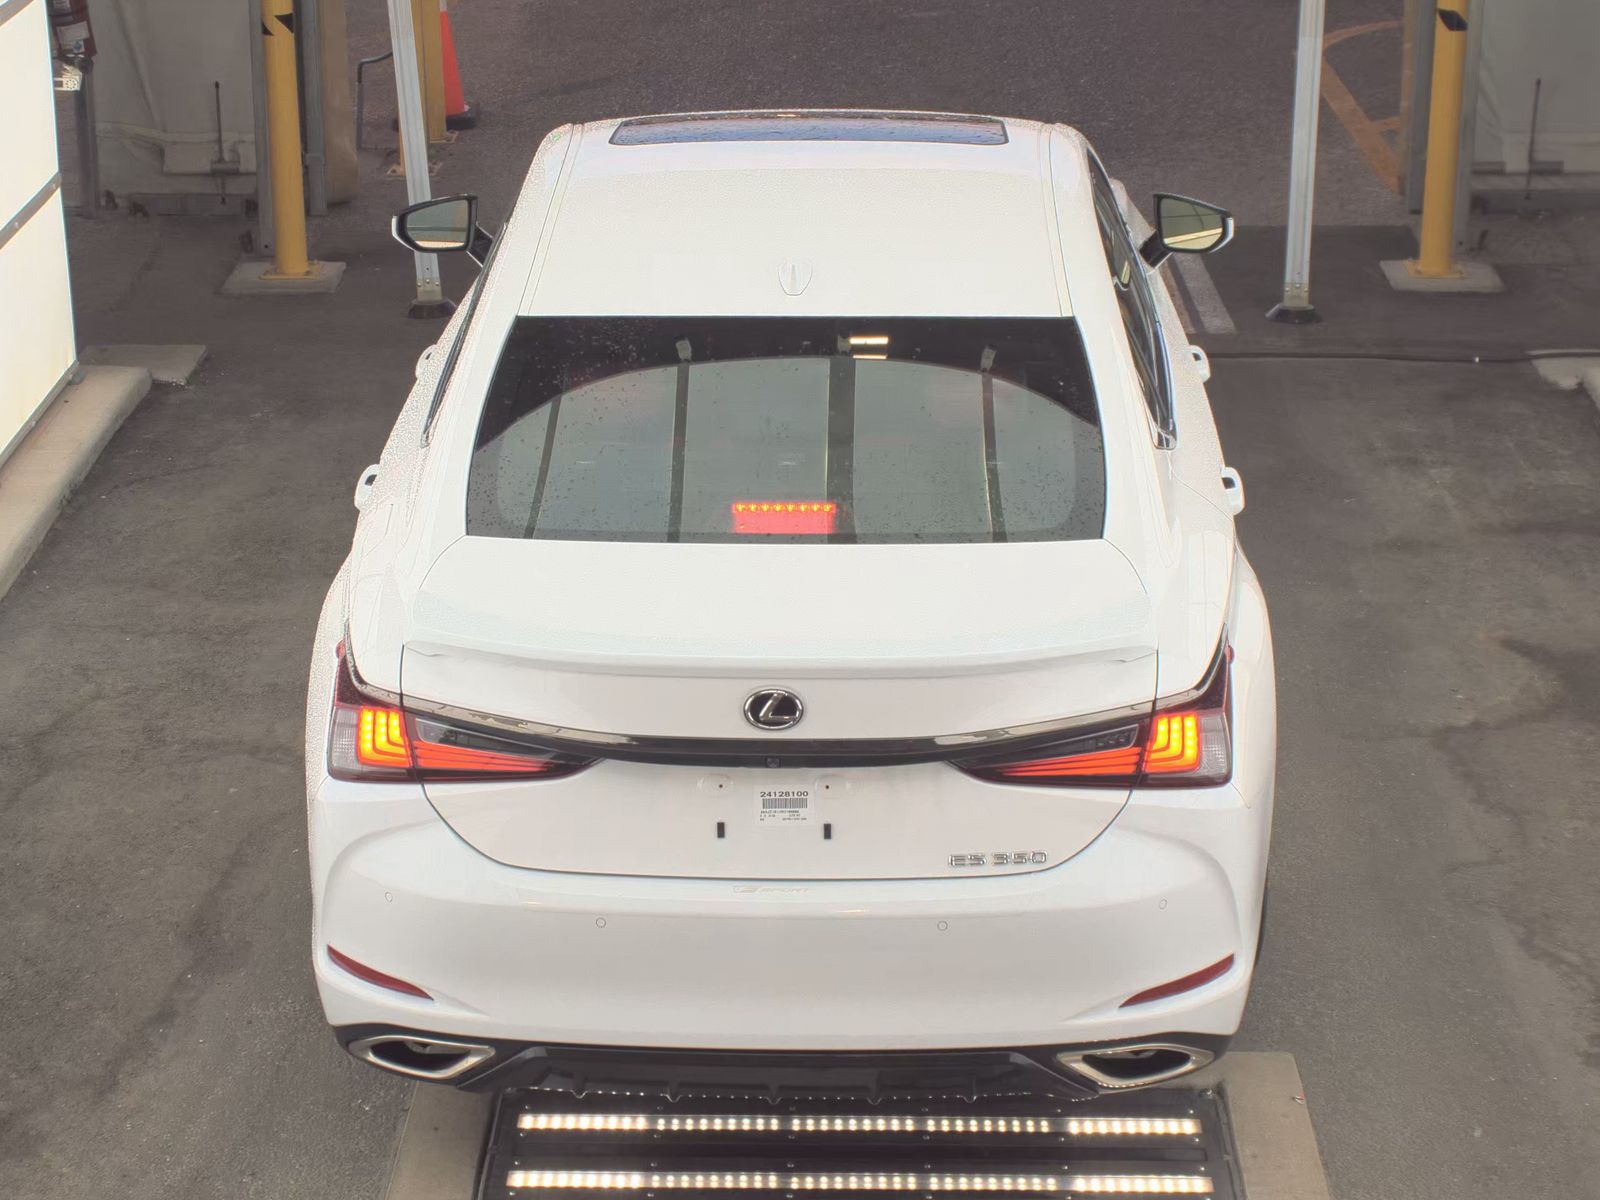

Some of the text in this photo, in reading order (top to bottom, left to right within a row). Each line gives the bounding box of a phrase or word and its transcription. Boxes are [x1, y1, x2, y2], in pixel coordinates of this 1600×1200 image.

[759, 790, 809, 798] 24128100
[948, 850, 1048, 867] ES 350
